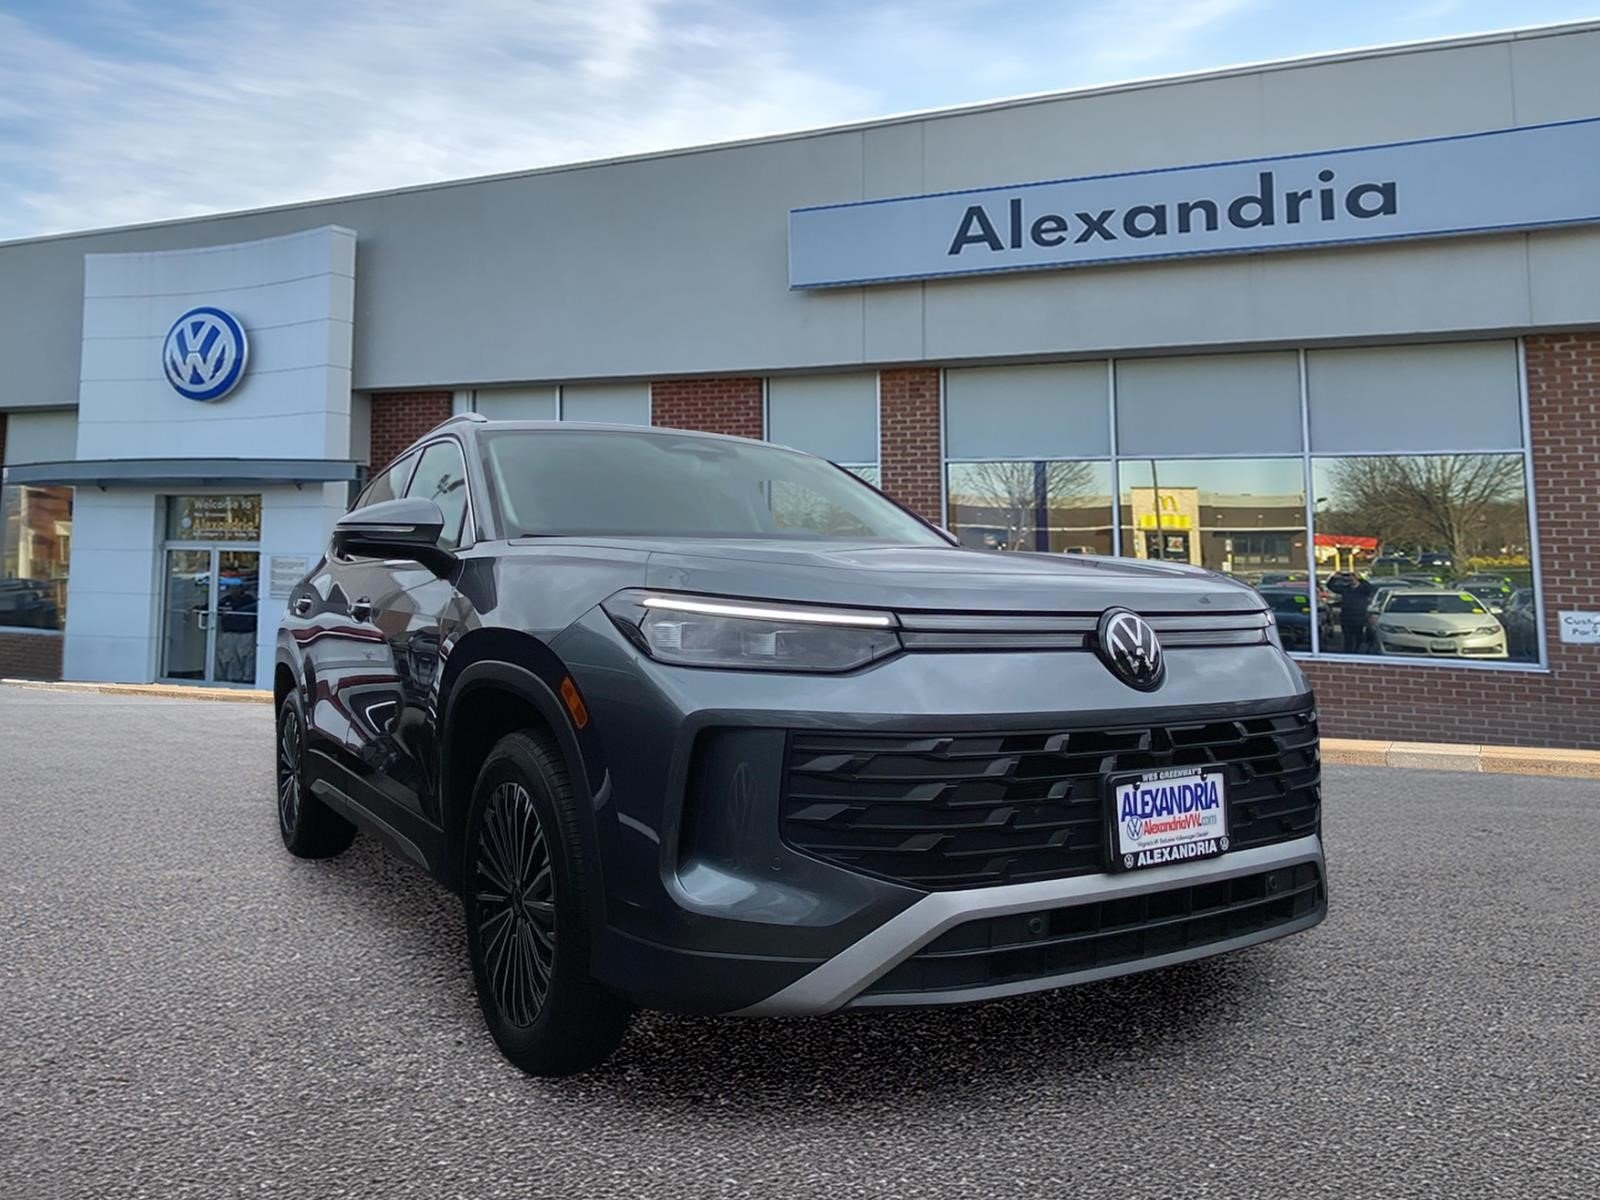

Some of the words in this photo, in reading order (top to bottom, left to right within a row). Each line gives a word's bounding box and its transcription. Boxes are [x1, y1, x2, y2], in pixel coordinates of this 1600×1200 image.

[948, 169, 1397, 255] Alexandria
[1120, 780, 1220, 822] ALEXANDRIA
[1137, 839, 1218, 867] ALEXANDRIA
